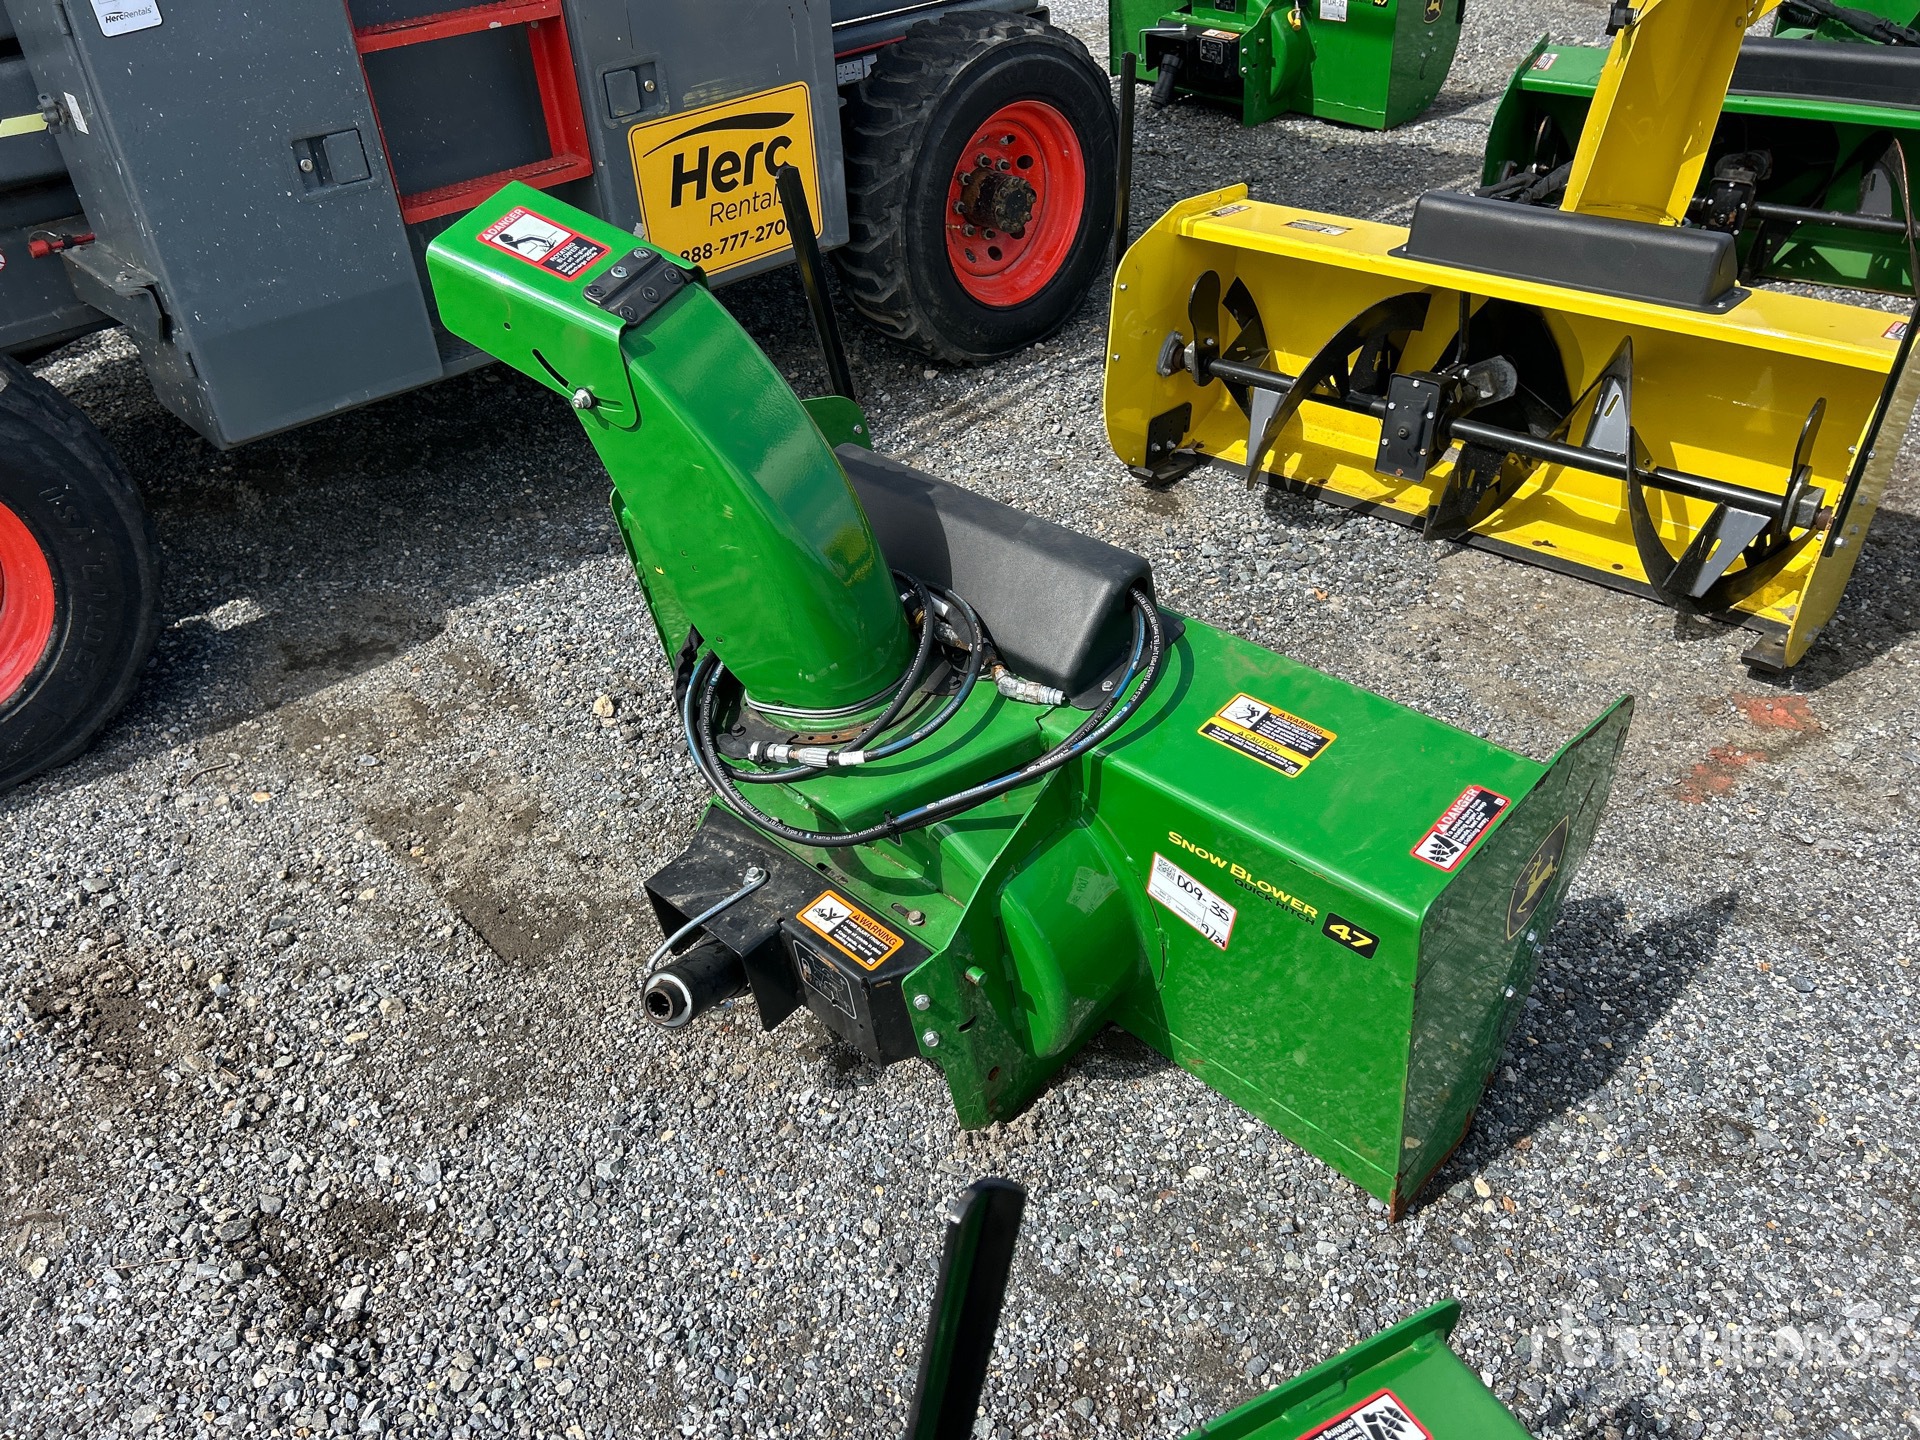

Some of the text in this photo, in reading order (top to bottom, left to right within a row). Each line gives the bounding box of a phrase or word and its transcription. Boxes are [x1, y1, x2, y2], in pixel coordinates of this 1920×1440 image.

[671, 136, 792, 208] Herc
[710, 183, 782, 226] Rental
[491, 208, 526, 235] DANGER
[548, 242, 577, 262] ROTATING
[555, 245, 581, 263] BLOWER
[680, 219, 786, 262] 888-777-270
[1287, 714, 1324, 735] WARNING
[1245, 733, 1280, 753] CAUTION
[1441, 788, 1480, 827] DANGER
[1449, 819, 1464, 831] avoid
[1459, 808, 1474, 821] injury
[1469, 798, 1482, 809] from
[1168, 831, 1227, 869] SNOW
[1230, 863, 1319, 918] BLOWER
[1234, 878, 1273, 904] QUICK
[1275, 900, 1315, 926] HITCH
[844, 919, 890, 951] AVOID INJURY FROM PTO
[859, 915, 898, 948] WARNING
[1329, 924, 1373, 947] 47
[1323, 1419, 1354, 1439] clothing
